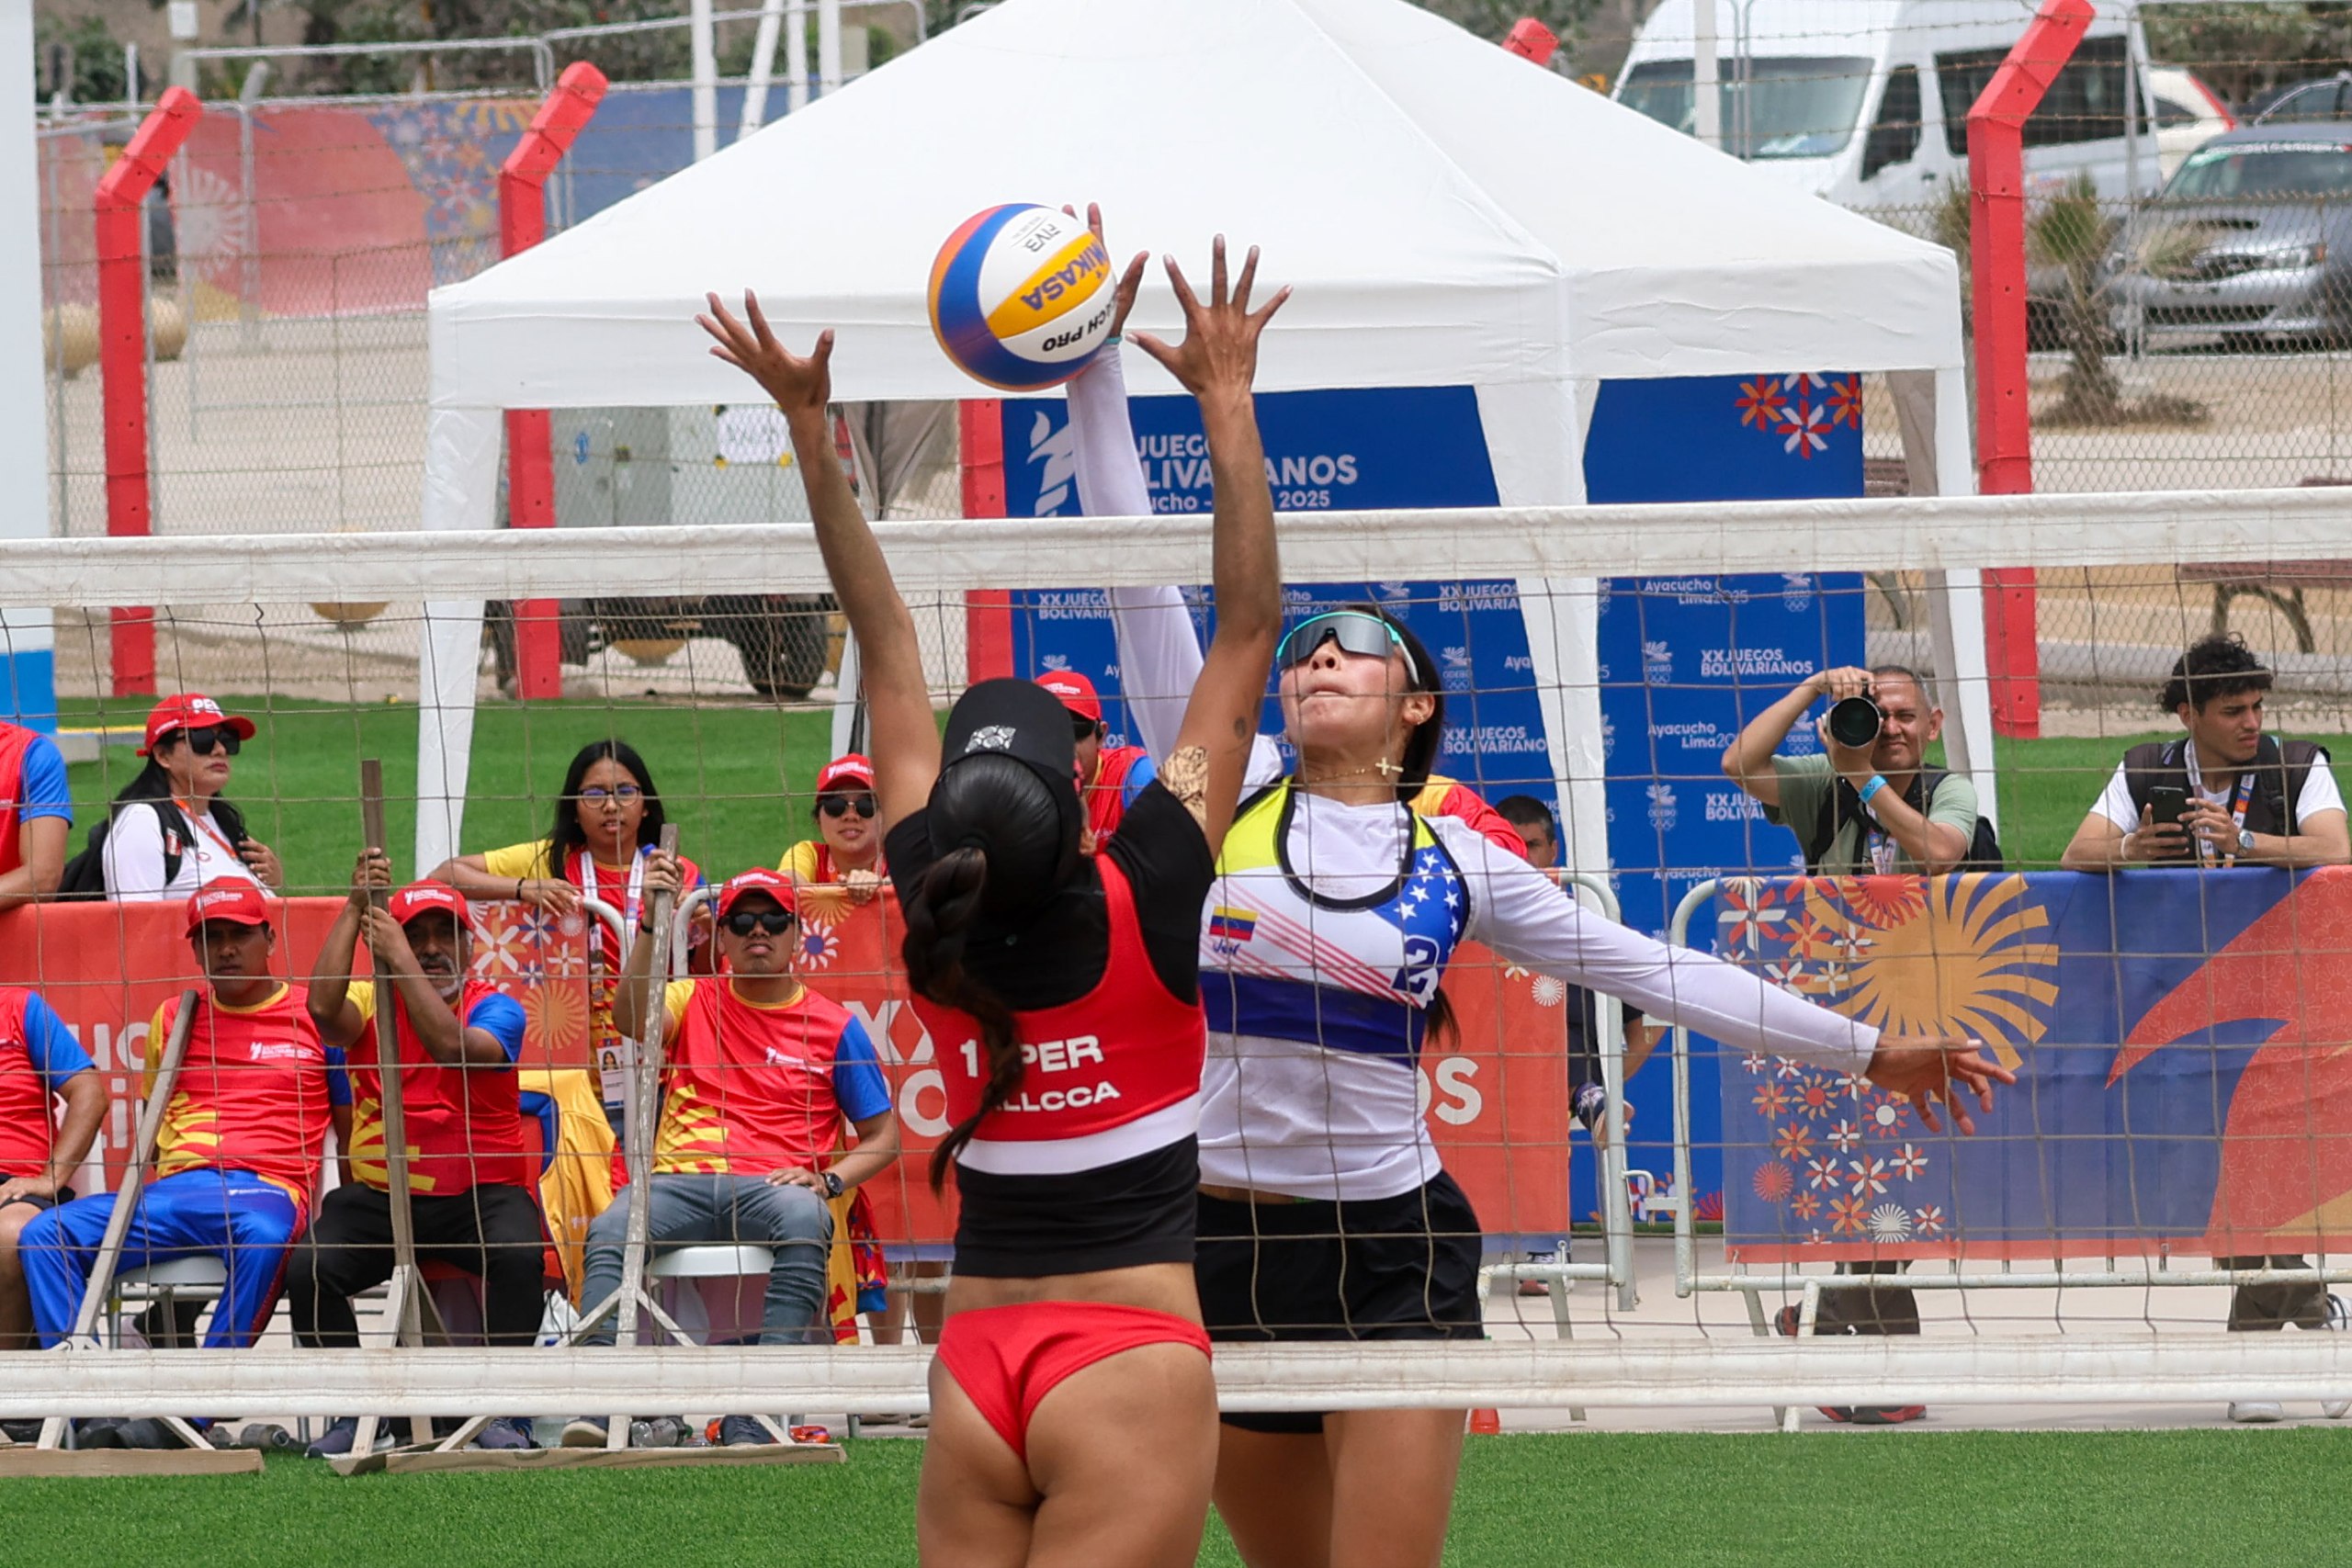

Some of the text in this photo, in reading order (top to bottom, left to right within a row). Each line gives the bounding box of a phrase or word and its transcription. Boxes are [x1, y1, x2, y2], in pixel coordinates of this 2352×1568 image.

[1020, 242, 1108, 310] MIKASA
[1042, 325, 1084, 352] PRO
[1278, 491, 1330, 509] 2025
[1644, 578, 1712, 593] Ayacucho
[1702, 649, 1783, 662] XX JUEGOS
[1702, 660, 1815, 677] BOLIVARIANOS
[1469, 727, 1527, 739] JUEGOS
[1648, 721, 1716, 739] Ayacucho
[1442, 739, 1547, 753] BOLIVARIANO
[1705, 794, 1729, 807] XX
[1392, 935, 1439, 996] 2
[959, 1034, 1104, 1078] 1 PER
